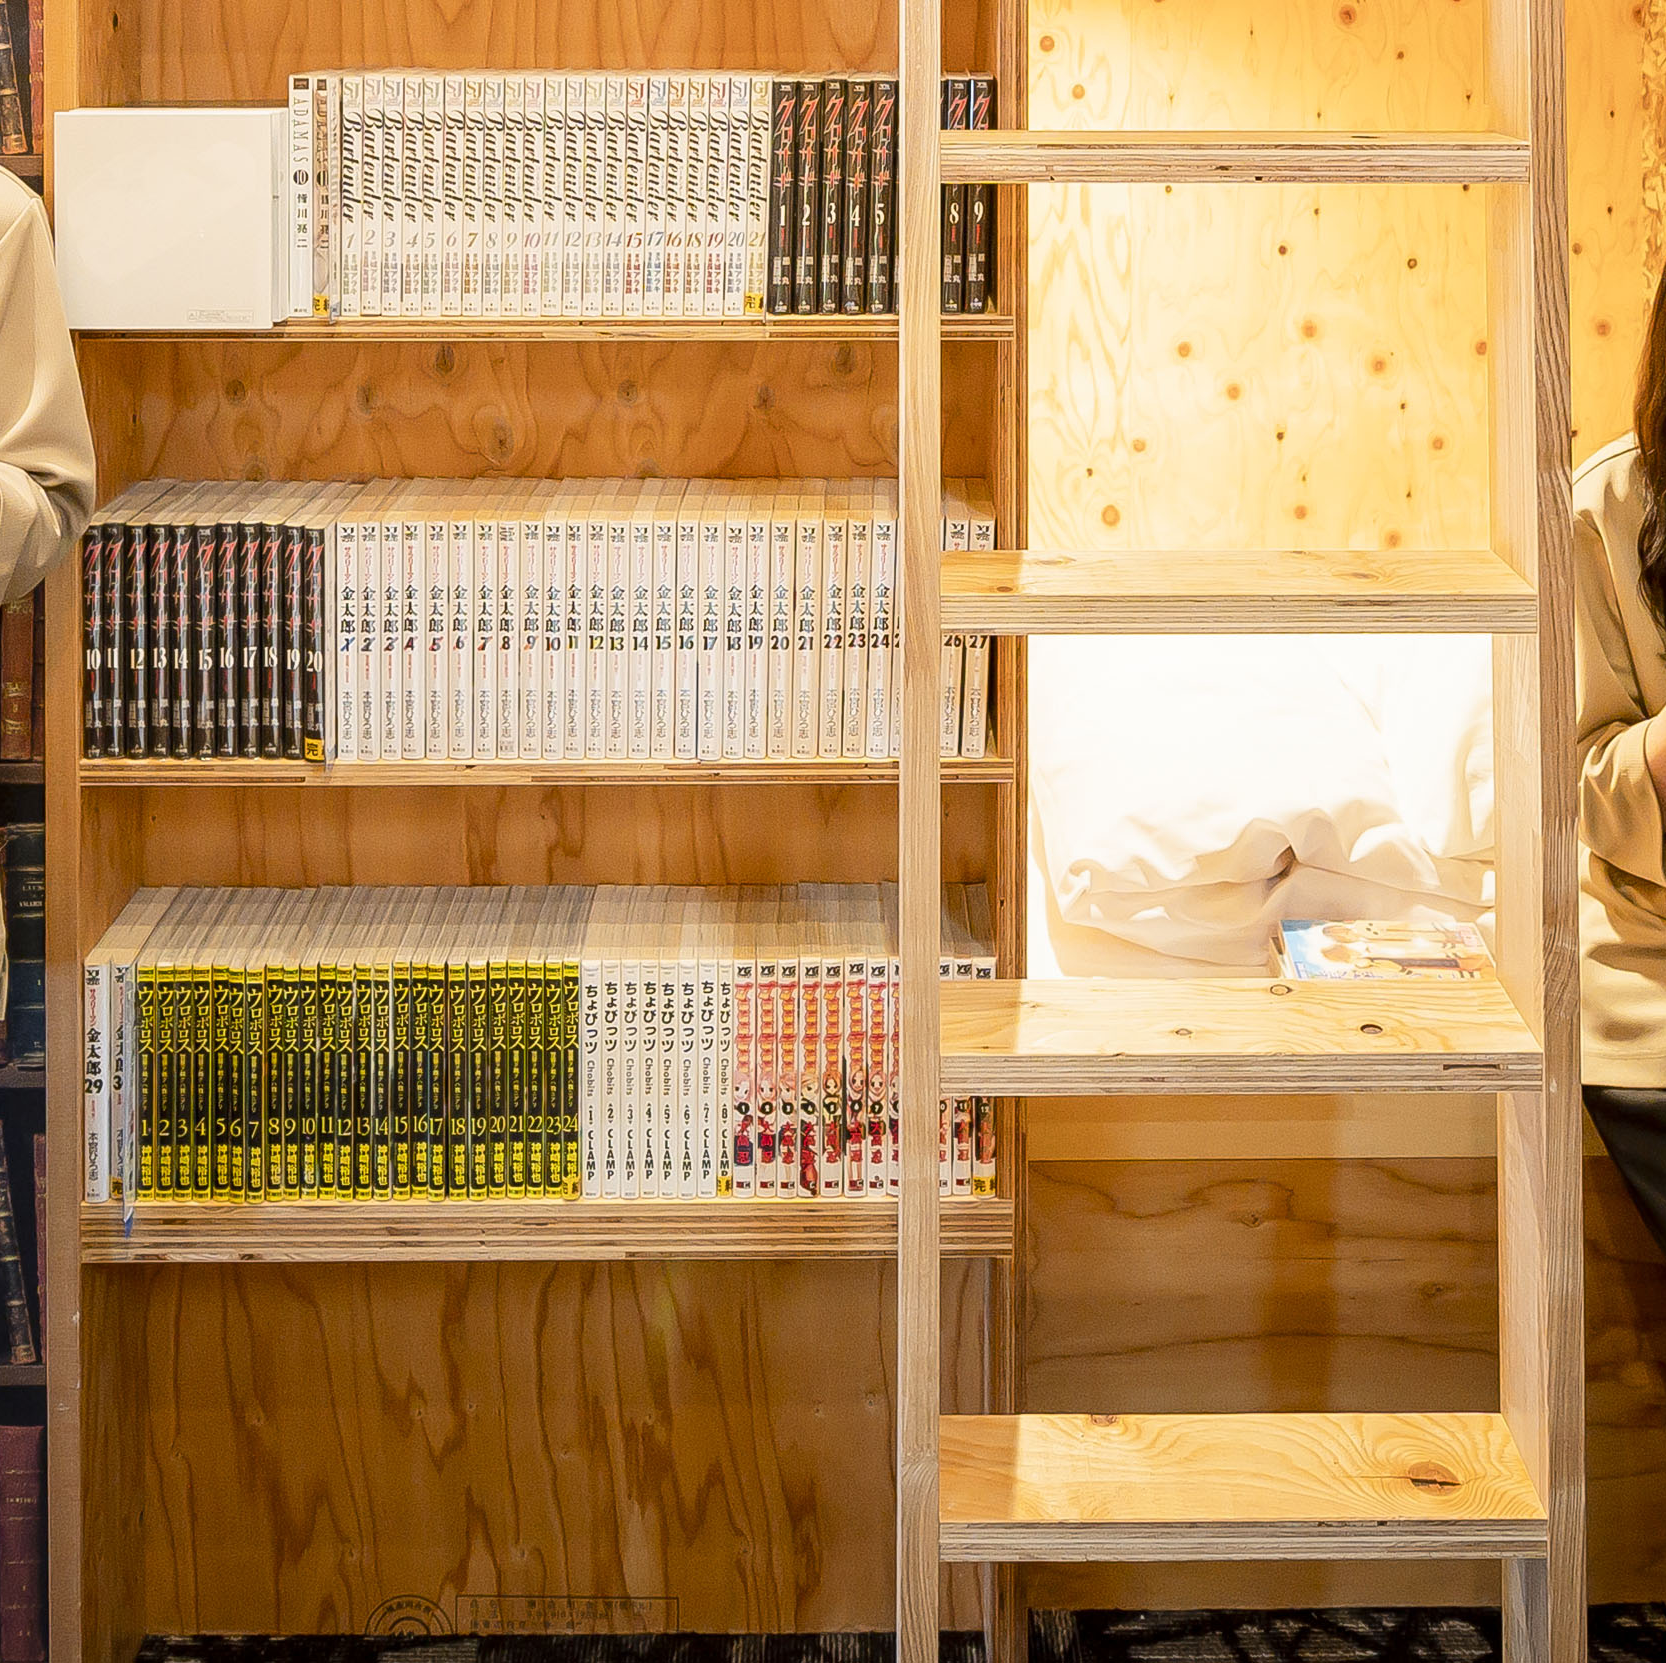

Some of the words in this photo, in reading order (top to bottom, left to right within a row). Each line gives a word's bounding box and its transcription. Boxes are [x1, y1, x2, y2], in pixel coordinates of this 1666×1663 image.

[342, 111, 363, 224] Bartender
[625, 111, 645, 223] Bartender
[779, 205, 786, 226] 1
[827, 203, 837, 224] 3
[875, 203, 885, 225] 5
[467, 232, 478, 249] 7
[626, 232, 643, 248] 15
[360, 585, 377, 634] 金太郎
[545, 584, 561, 634] 金太郎
[873, 584, 890, 632] 金太郎
[360, 636, 374, 652] 2
[545, 635, 562, 652] 10
[871, 635, 890, 650] 24
[152, 647, 167, 670] 13
[220, 647, 235, 668] 16
[137, 985, 155, 1054] ウロボロス
[193, 985, 212, 1053] ウロボロス
[603, 981, 619, 1053] ちょびっツ
[84, 1078, 104, 1094] 29
[605, 1057, 615, 1096] Chobits
[607, 1107, 615, 1120] 2
[194, 1117, 207, 1135] 4
[605, 1128, 616, 1181] CLAMP
